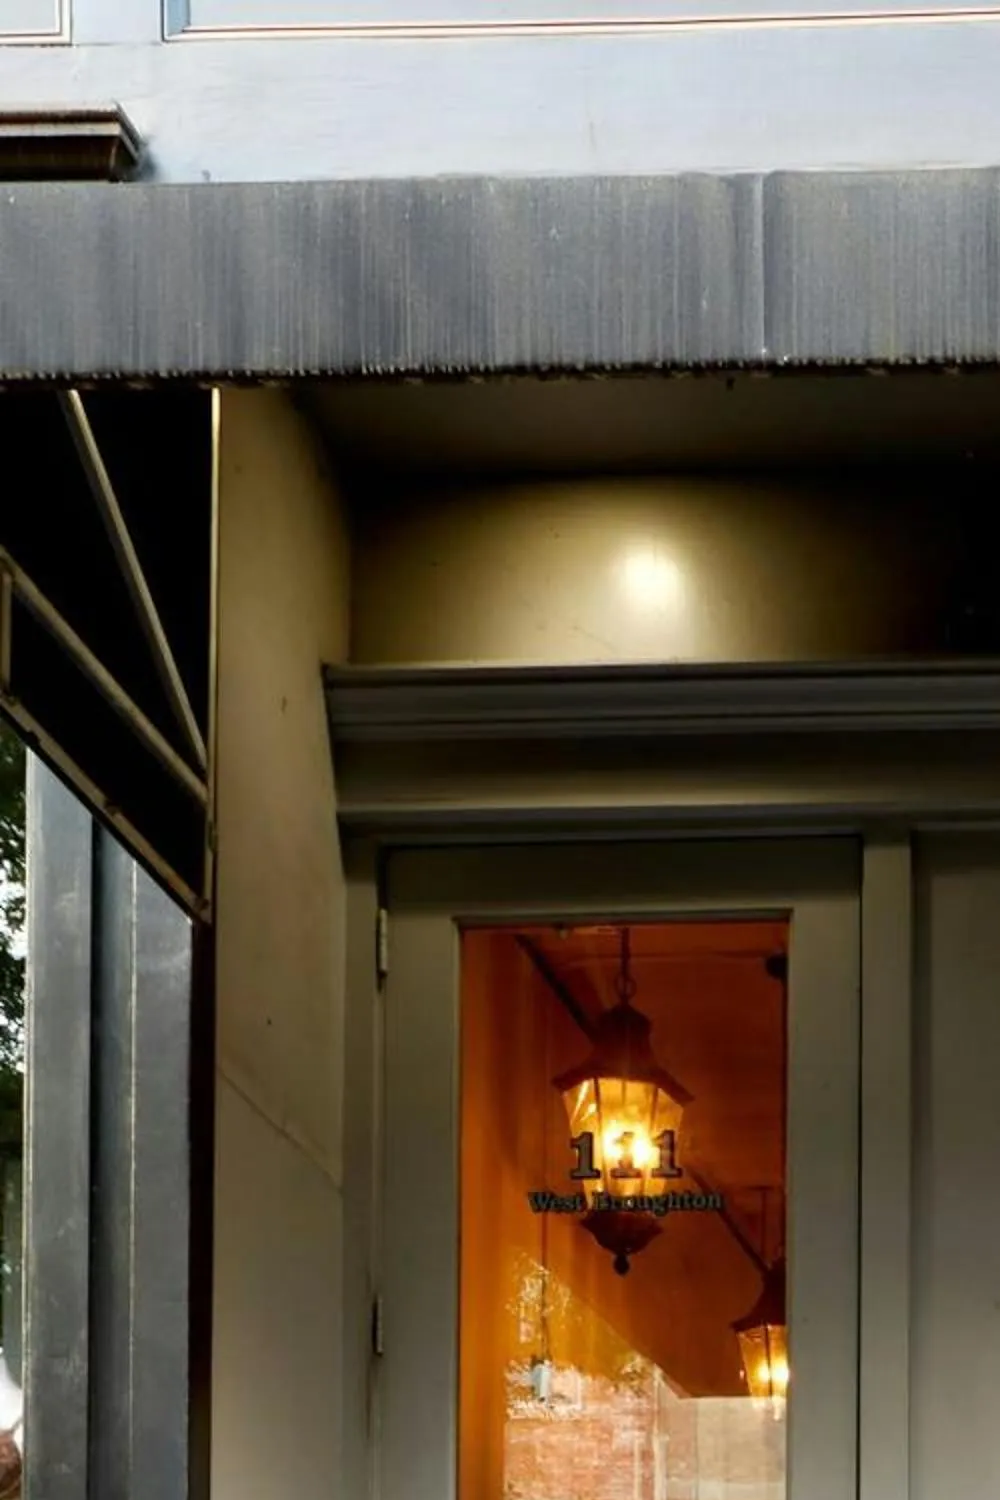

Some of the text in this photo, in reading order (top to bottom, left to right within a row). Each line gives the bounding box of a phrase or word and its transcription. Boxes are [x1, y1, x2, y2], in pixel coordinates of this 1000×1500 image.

[569, 1130, 683, 1179] 111
[528, 1191, 724, 1216] West Broughton
